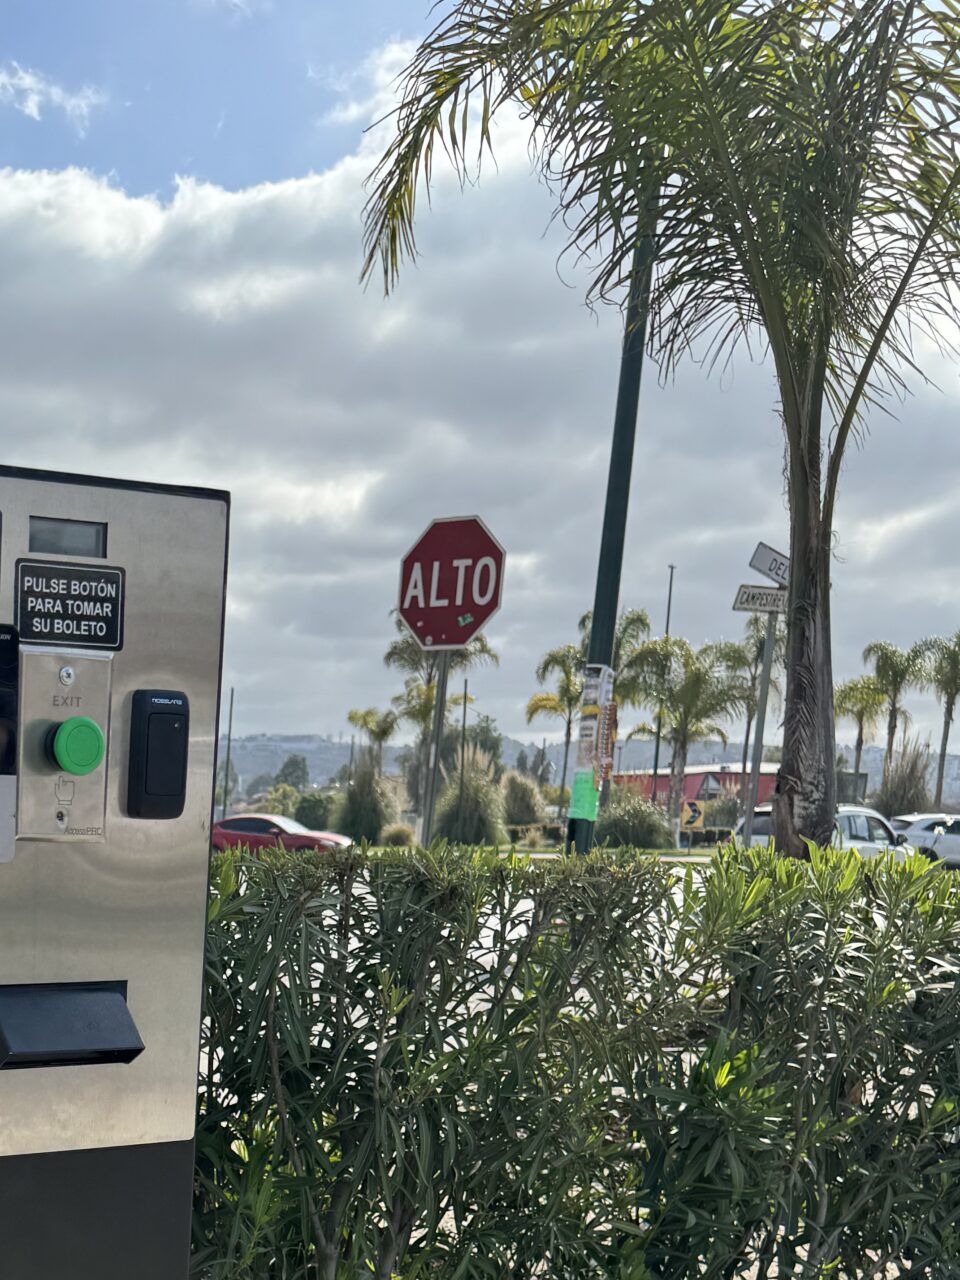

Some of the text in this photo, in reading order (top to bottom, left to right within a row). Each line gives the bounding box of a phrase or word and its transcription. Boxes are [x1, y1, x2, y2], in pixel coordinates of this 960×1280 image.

[768, 558, 788, 580] DEL
[24, 576, 116, 598] PULSE BOTÓN
[403, 556, 497, 609] ALTO
[28, 598, 112, 617] PARA TOMAR
[32, 618, 106, 636] SU BOLETO
[52, 695, 83, 708] EXIT
